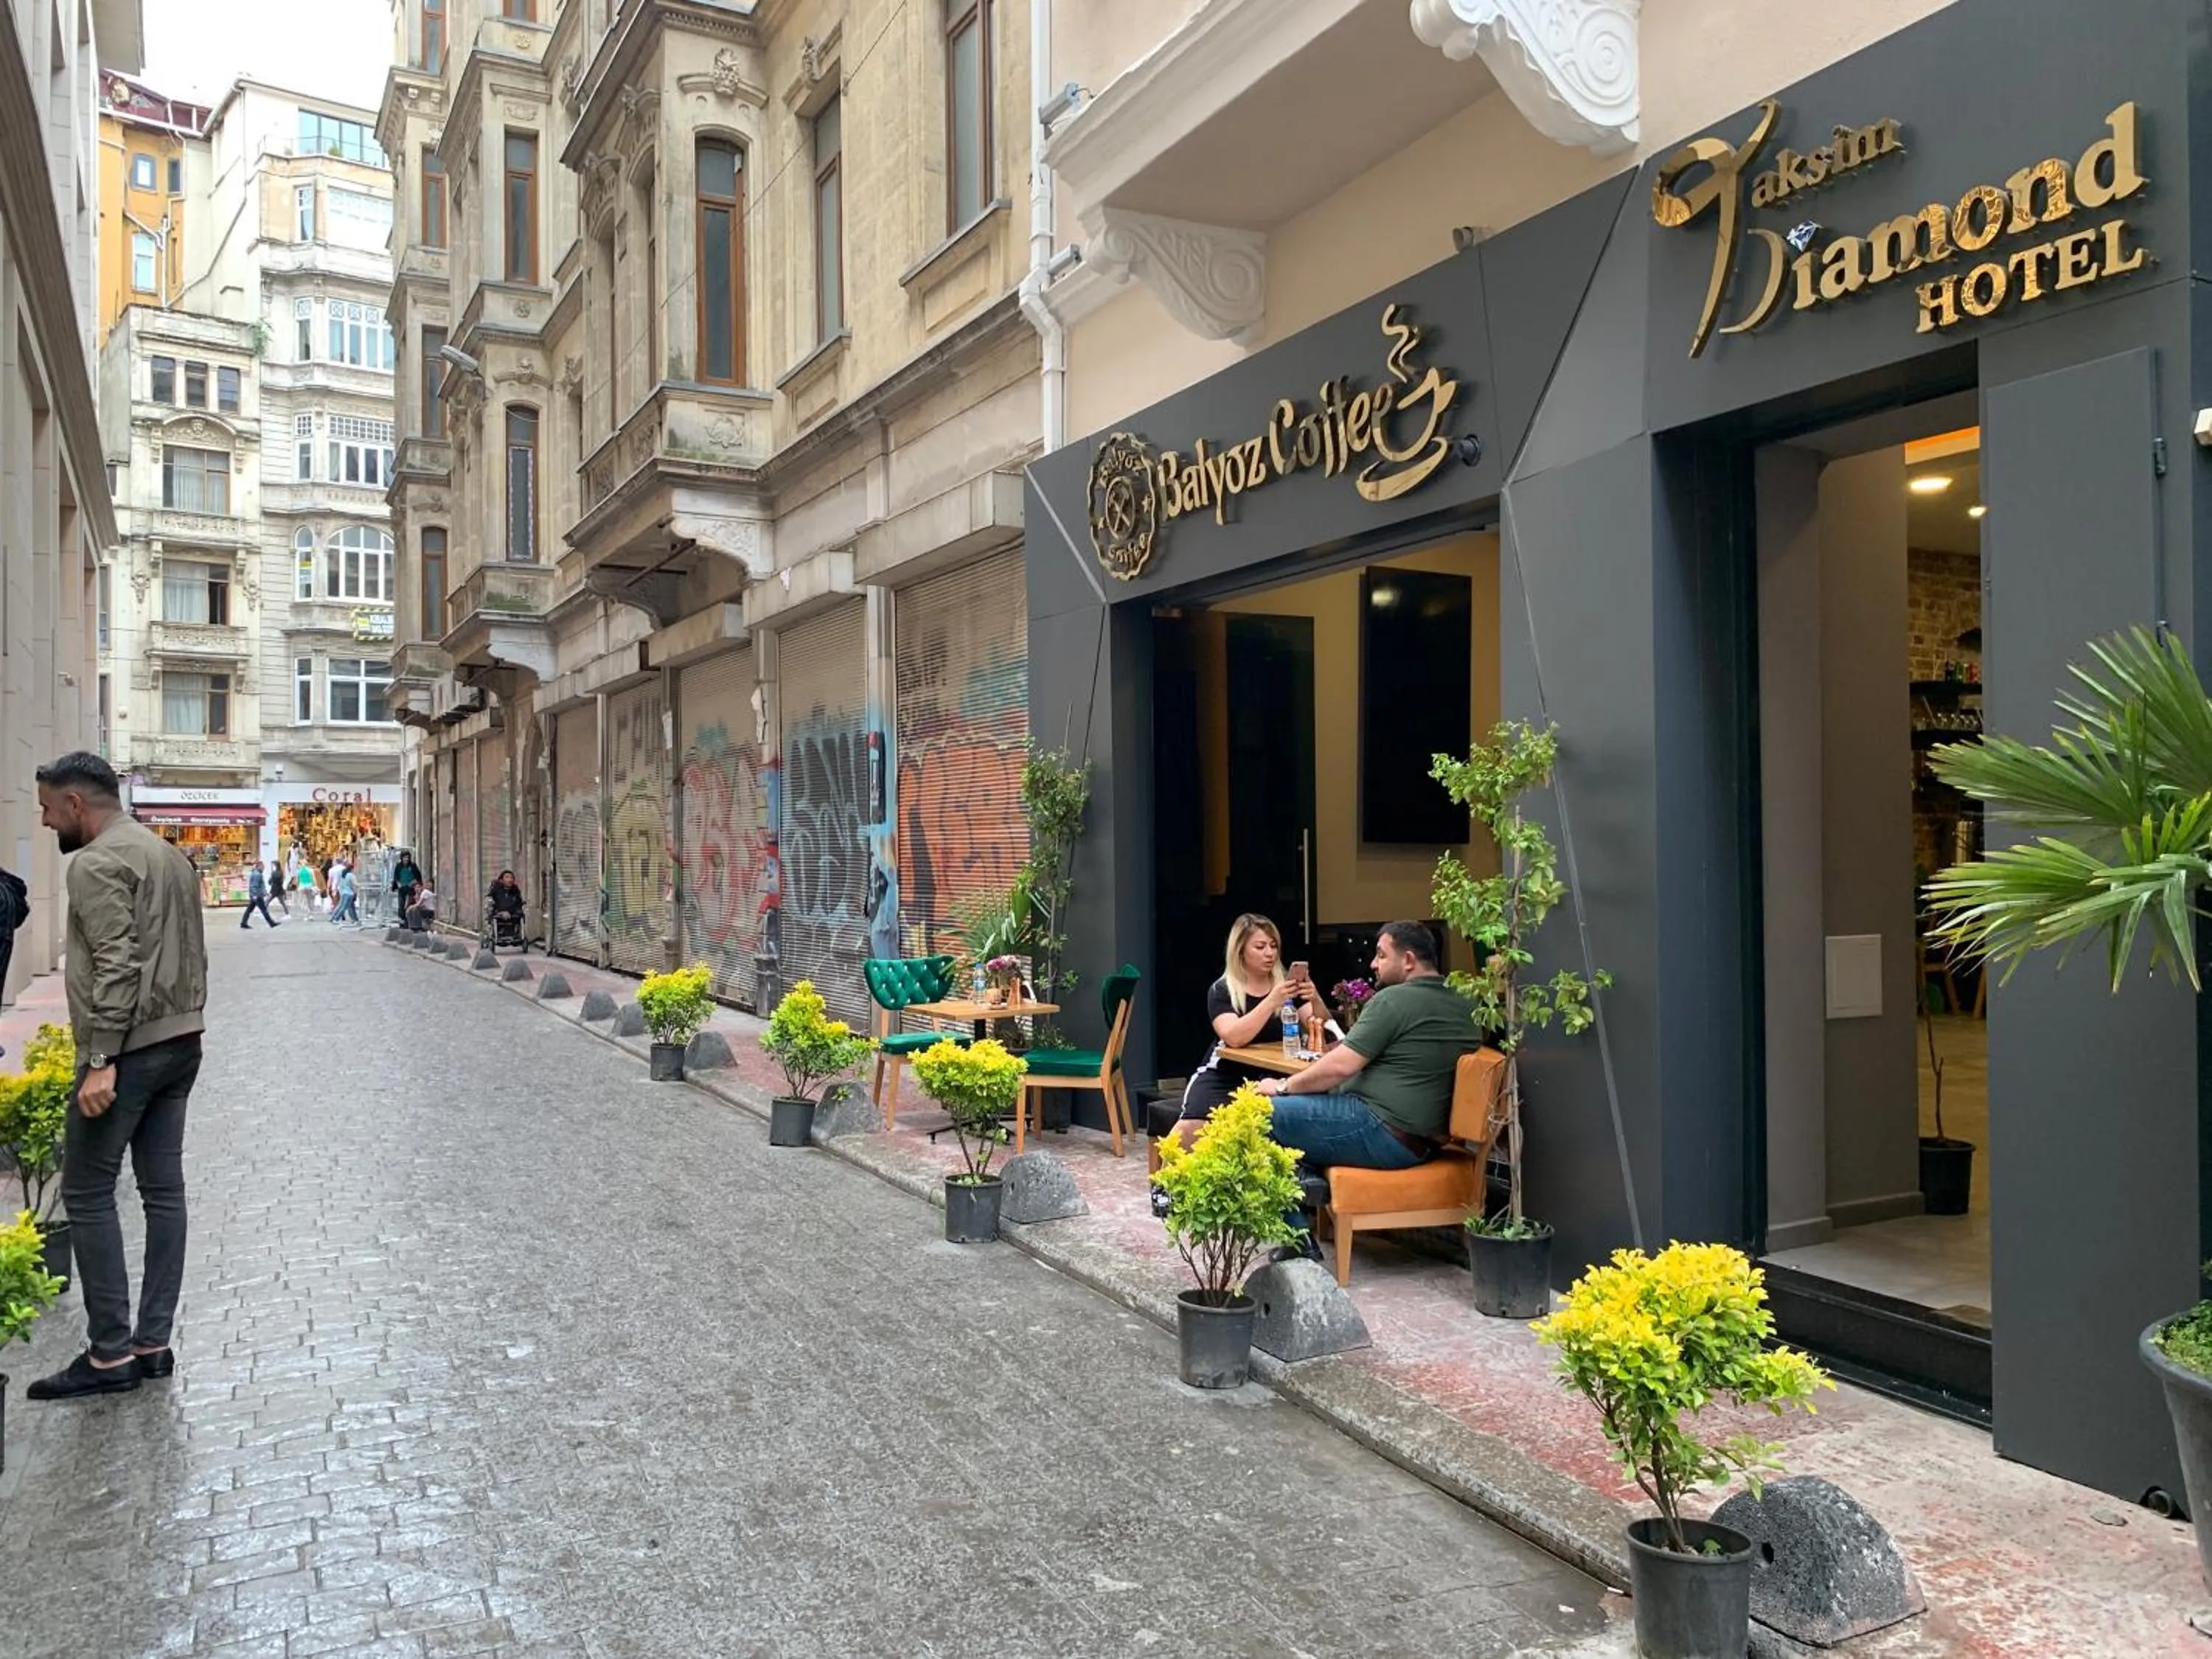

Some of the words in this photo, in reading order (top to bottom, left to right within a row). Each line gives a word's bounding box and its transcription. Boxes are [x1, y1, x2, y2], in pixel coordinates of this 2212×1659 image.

[1651, 98, 1904, 359] Taksim
[1719, 101, 2147, 335] Diamond
[1916, 220, 2147, 333] HOTEL
[1158, 437, 1267, 526] Balyoz
[1268, 375, 1397, 478] Coffee
[312, 787, 372, 802] Coral
